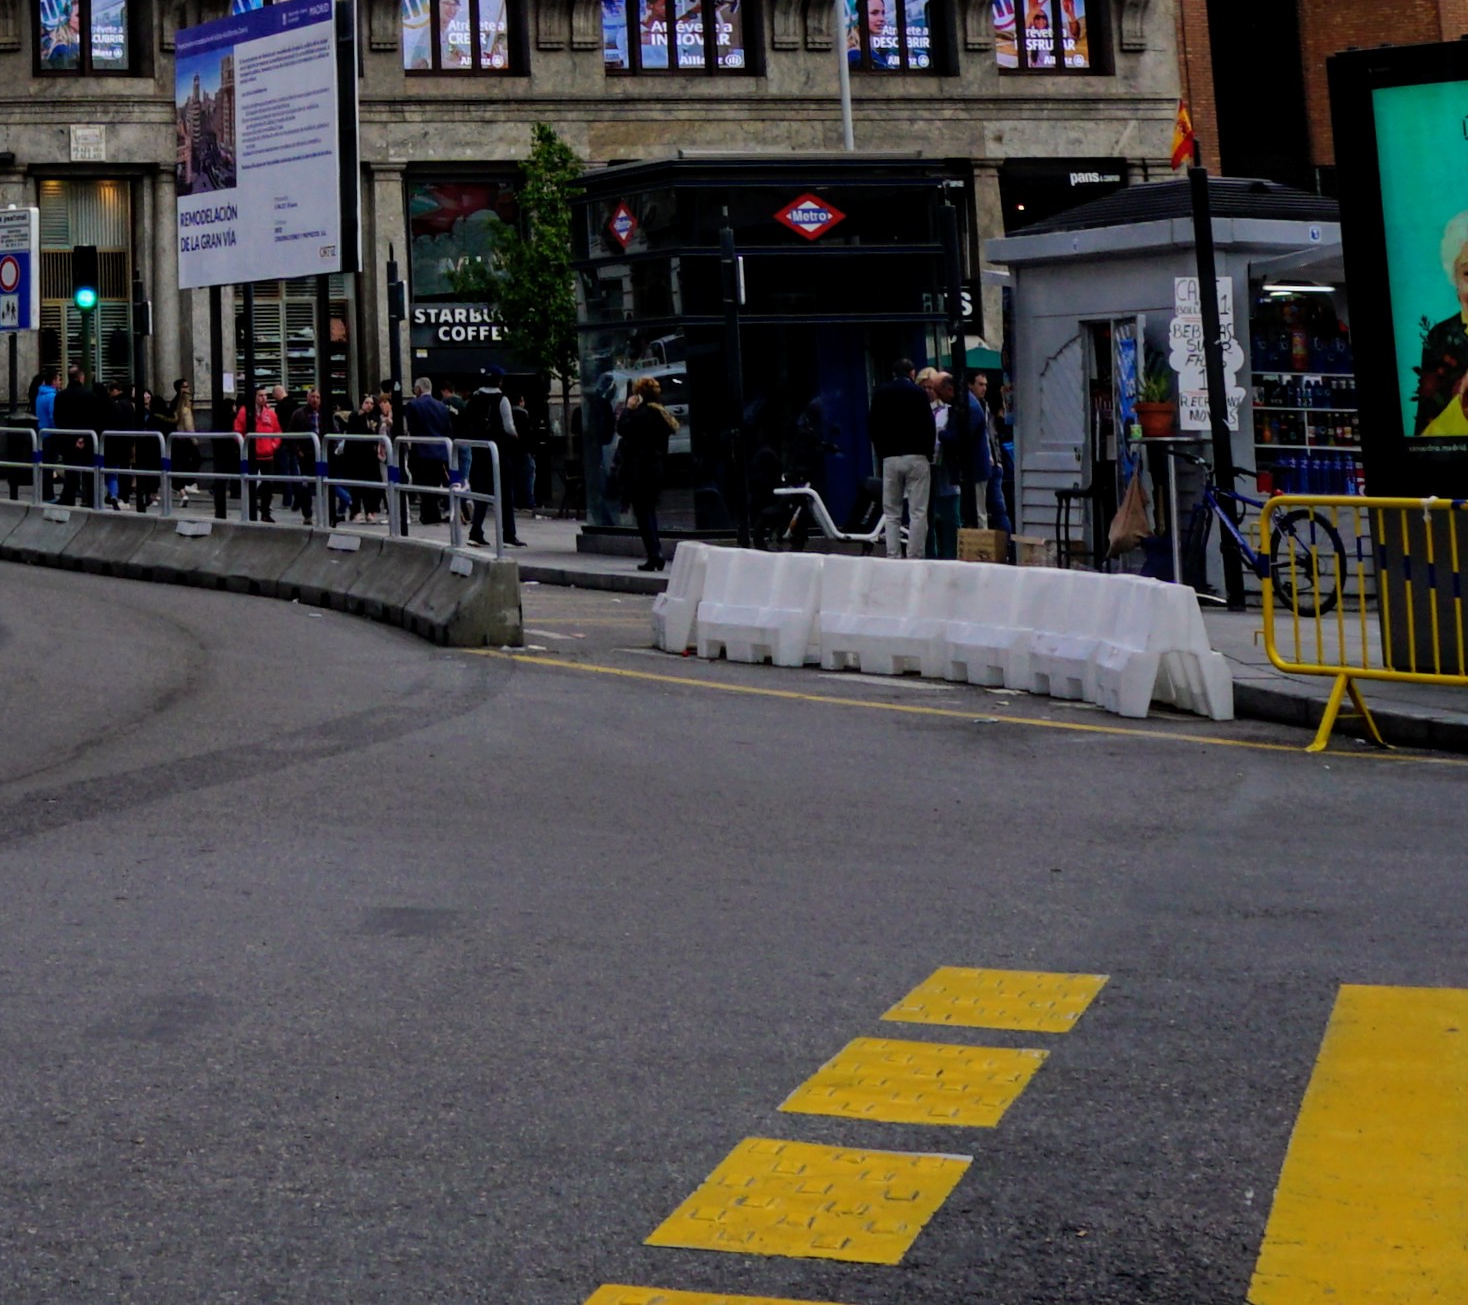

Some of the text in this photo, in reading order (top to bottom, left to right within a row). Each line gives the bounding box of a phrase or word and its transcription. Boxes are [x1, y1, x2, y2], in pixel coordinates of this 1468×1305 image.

[448, 33, 488, 45] CRER
[873, 36, 931, 48] DESCBRIR
[1070, 173, 1100, 187] pans
[180, 203, 238, 228] REMODELACIÓN
[793, 210, 827, 222] Metro
[180, 227, 237, 252] DE LA GRAN VÍA
[414, 306, 504, 324] STARBU
